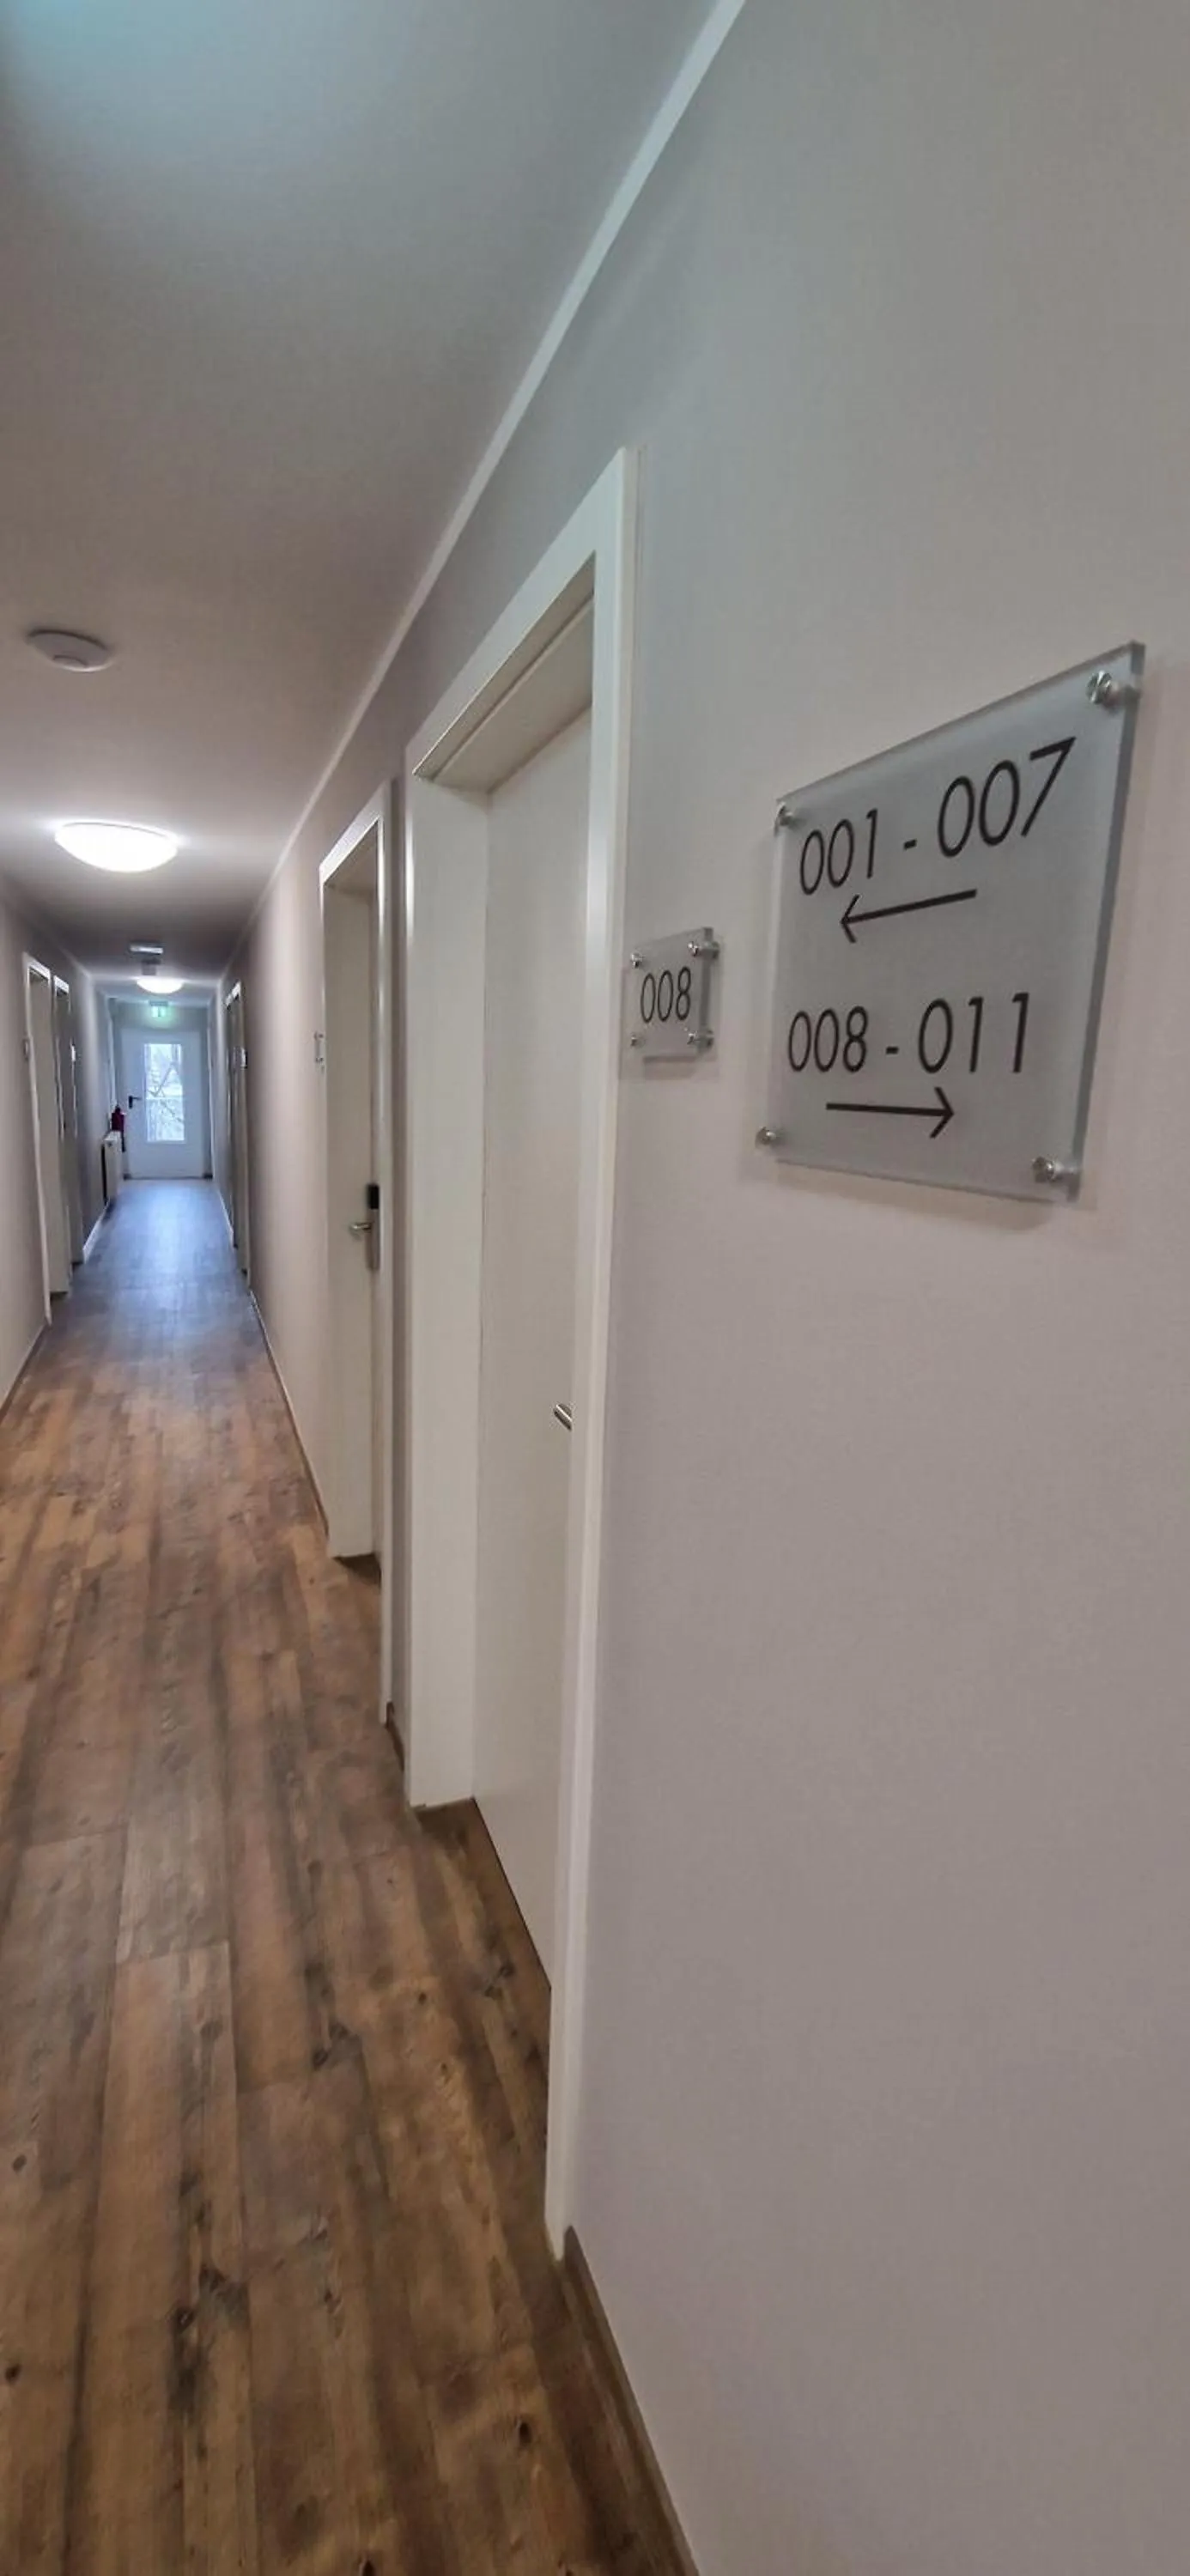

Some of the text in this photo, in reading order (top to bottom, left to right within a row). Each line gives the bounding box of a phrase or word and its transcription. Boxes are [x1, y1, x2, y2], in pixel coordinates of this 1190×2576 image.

[799, 736, 1077, 896] 001 - 007
[640, 966, 692, 1024] 008
[787, 1005, 869, 1074] 008
[917, 991, 1030, 1075] 011
